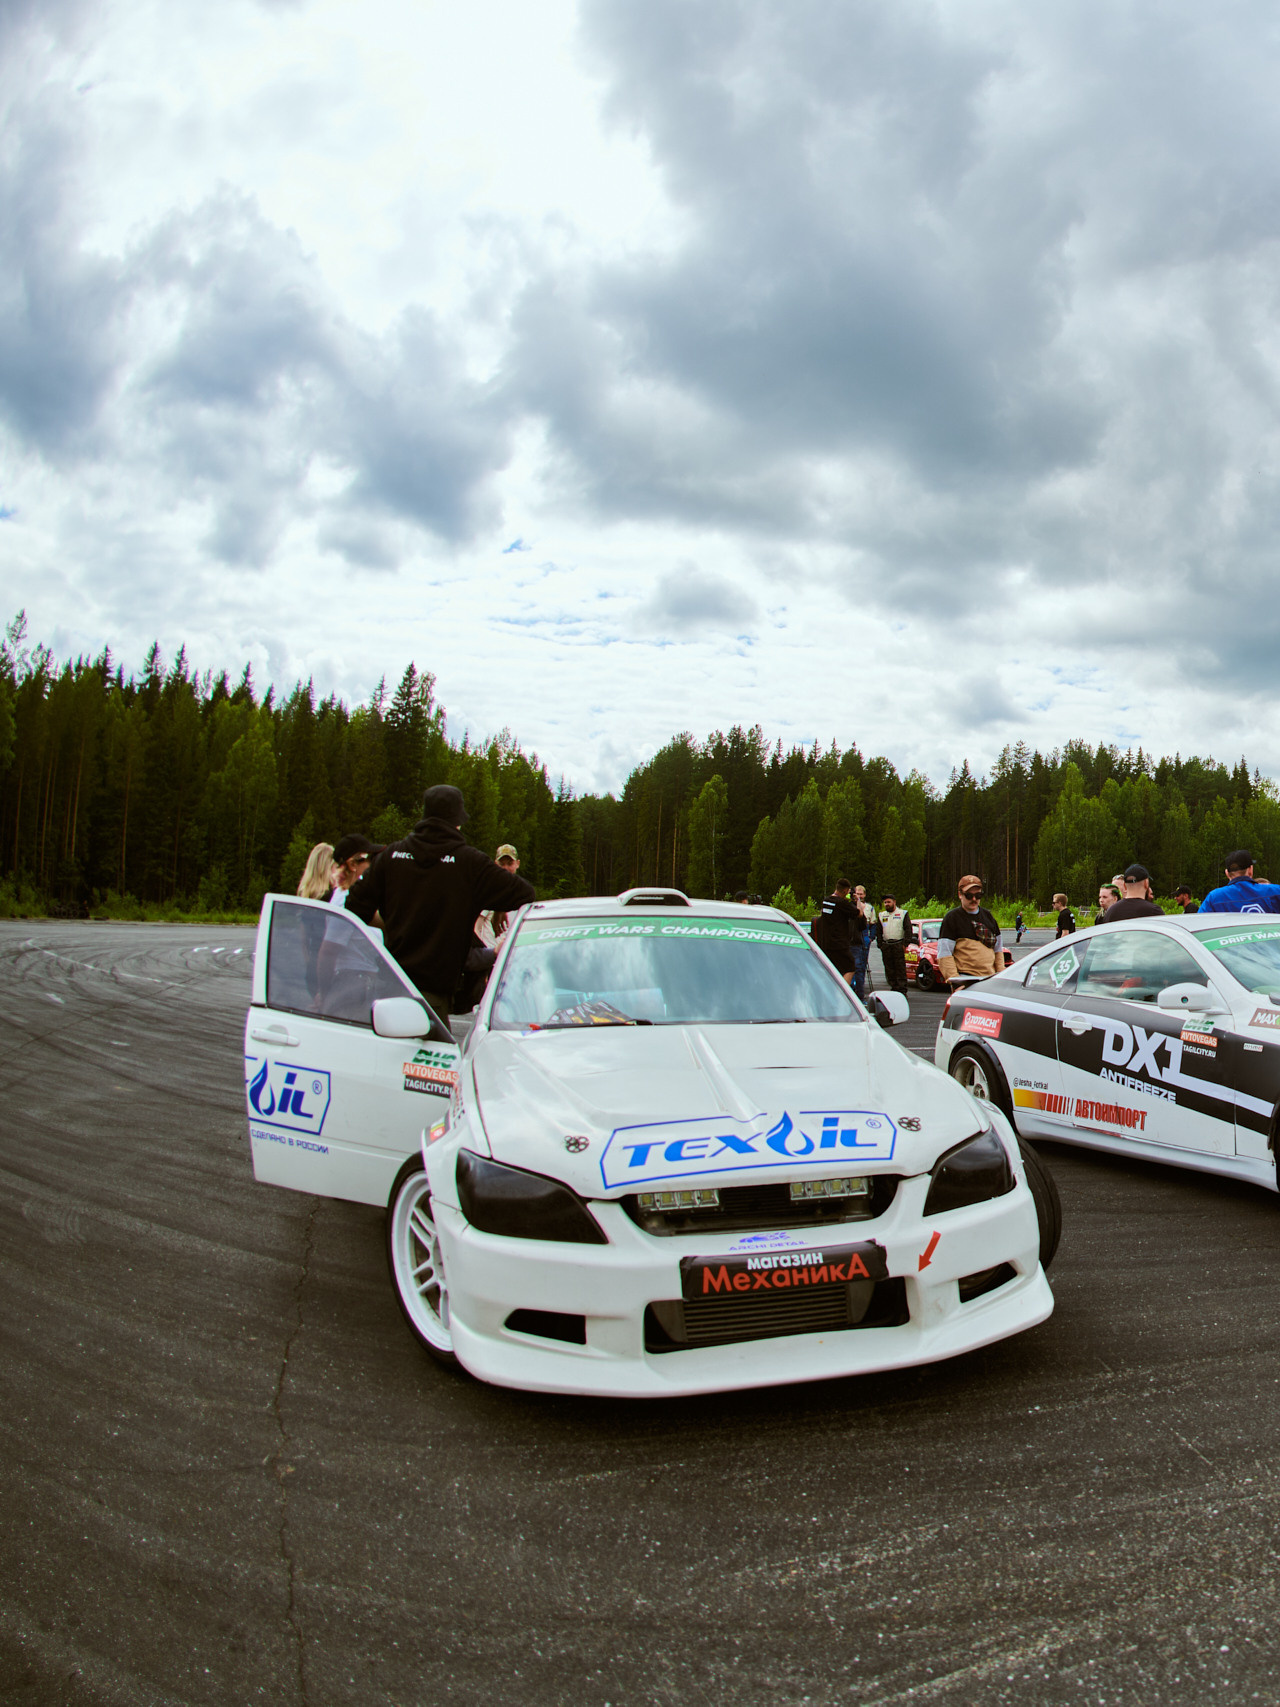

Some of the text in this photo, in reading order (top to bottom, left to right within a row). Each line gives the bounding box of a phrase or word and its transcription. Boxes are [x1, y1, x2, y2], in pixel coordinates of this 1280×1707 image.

[537, 926, 802, 944] DRIFT WARS CHAMPIONSHIP
[1220, 932, 1254, 946] DRIFT
[1056, 960, 1072, 974] 35
[971, 1015, 998, 1029] TOTACHI
[1254, 1012, 1280, 1025] MAX
[1181, 1031, 1217, 1047] AVTOVEGAS
[1102, 1020, 1183, 1081] DX1
[1183, 1045, 1216, 1058] TAGILCITY.RU
[404, 1064, 459, 1083] AVTOVEGAS
[1100, 1067, 1176, 1104] ANTIFREEZE
[1075, 1099, 1147, 1131] АВТОИМПОРТ
[251, 1129, 329, 1154] СДЕЛАНО В РОССИИ
[747, 1252, 824, 1270] магазин
[702, 1252, 870, 1294] МеханикА
